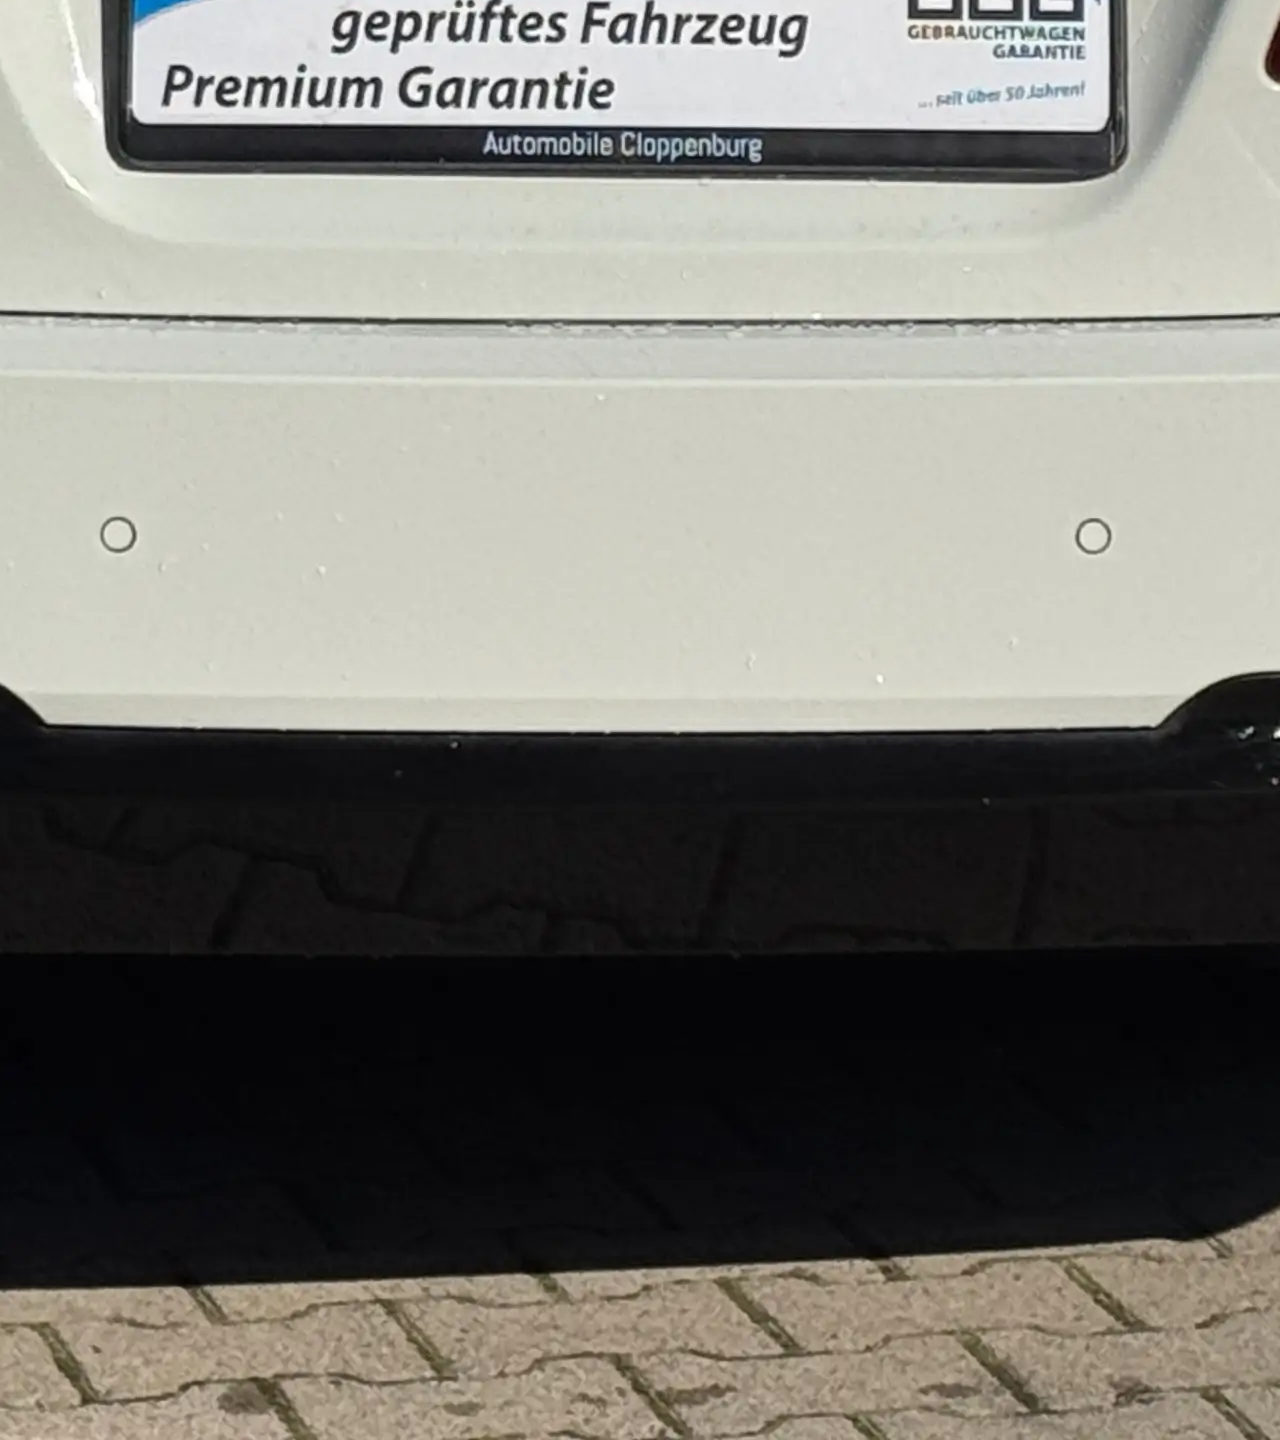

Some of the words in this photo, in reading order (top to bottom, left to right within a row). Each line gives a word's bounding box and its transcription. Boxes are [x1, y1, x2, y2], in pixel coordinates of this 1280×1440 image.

[580, 0, 809, 58] Fahrzeug
[907, 24, 1086, 41] GEBRAUCHTWAGEN
[992, 44, 1086, 60] GARANTIE
[161, 63, 383, 109] Premium
[397, 65, 615, 111] Garantie
[1005, 84, 1025, 102] 50
[482, 130, 614, 156] Automobile
[620, 132, 763, 163] Cloppenburg
